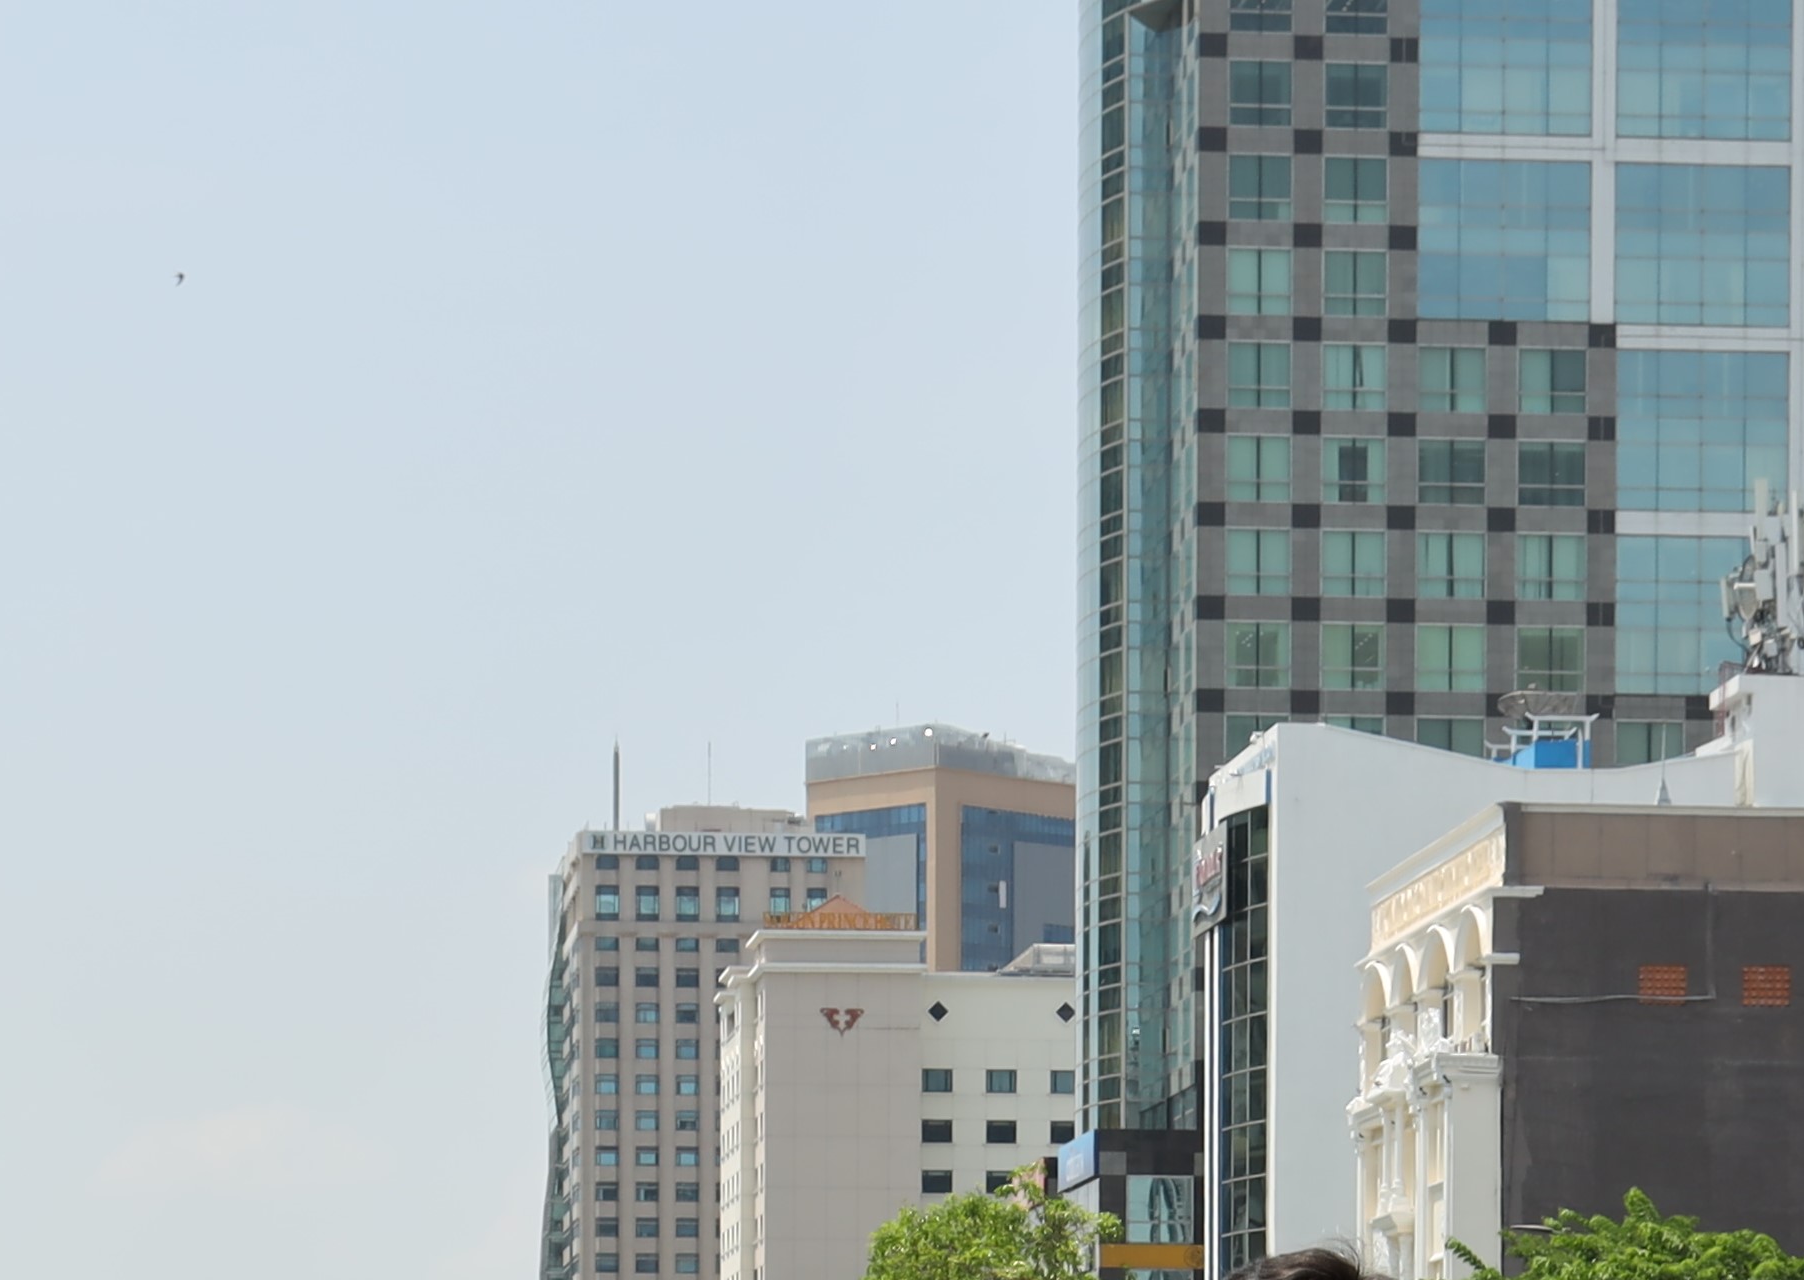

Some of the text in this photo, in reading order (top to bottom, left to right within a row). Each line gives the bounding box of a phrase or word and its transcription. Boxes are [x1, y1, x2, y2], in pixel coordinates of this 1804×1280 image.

[613, 834, 717, 852] HARBOUR
[722, 835, 777, 853] VIEW
[783, 836, 861, 855] TOWER
[819, 912, 871, 930] PRINCE
